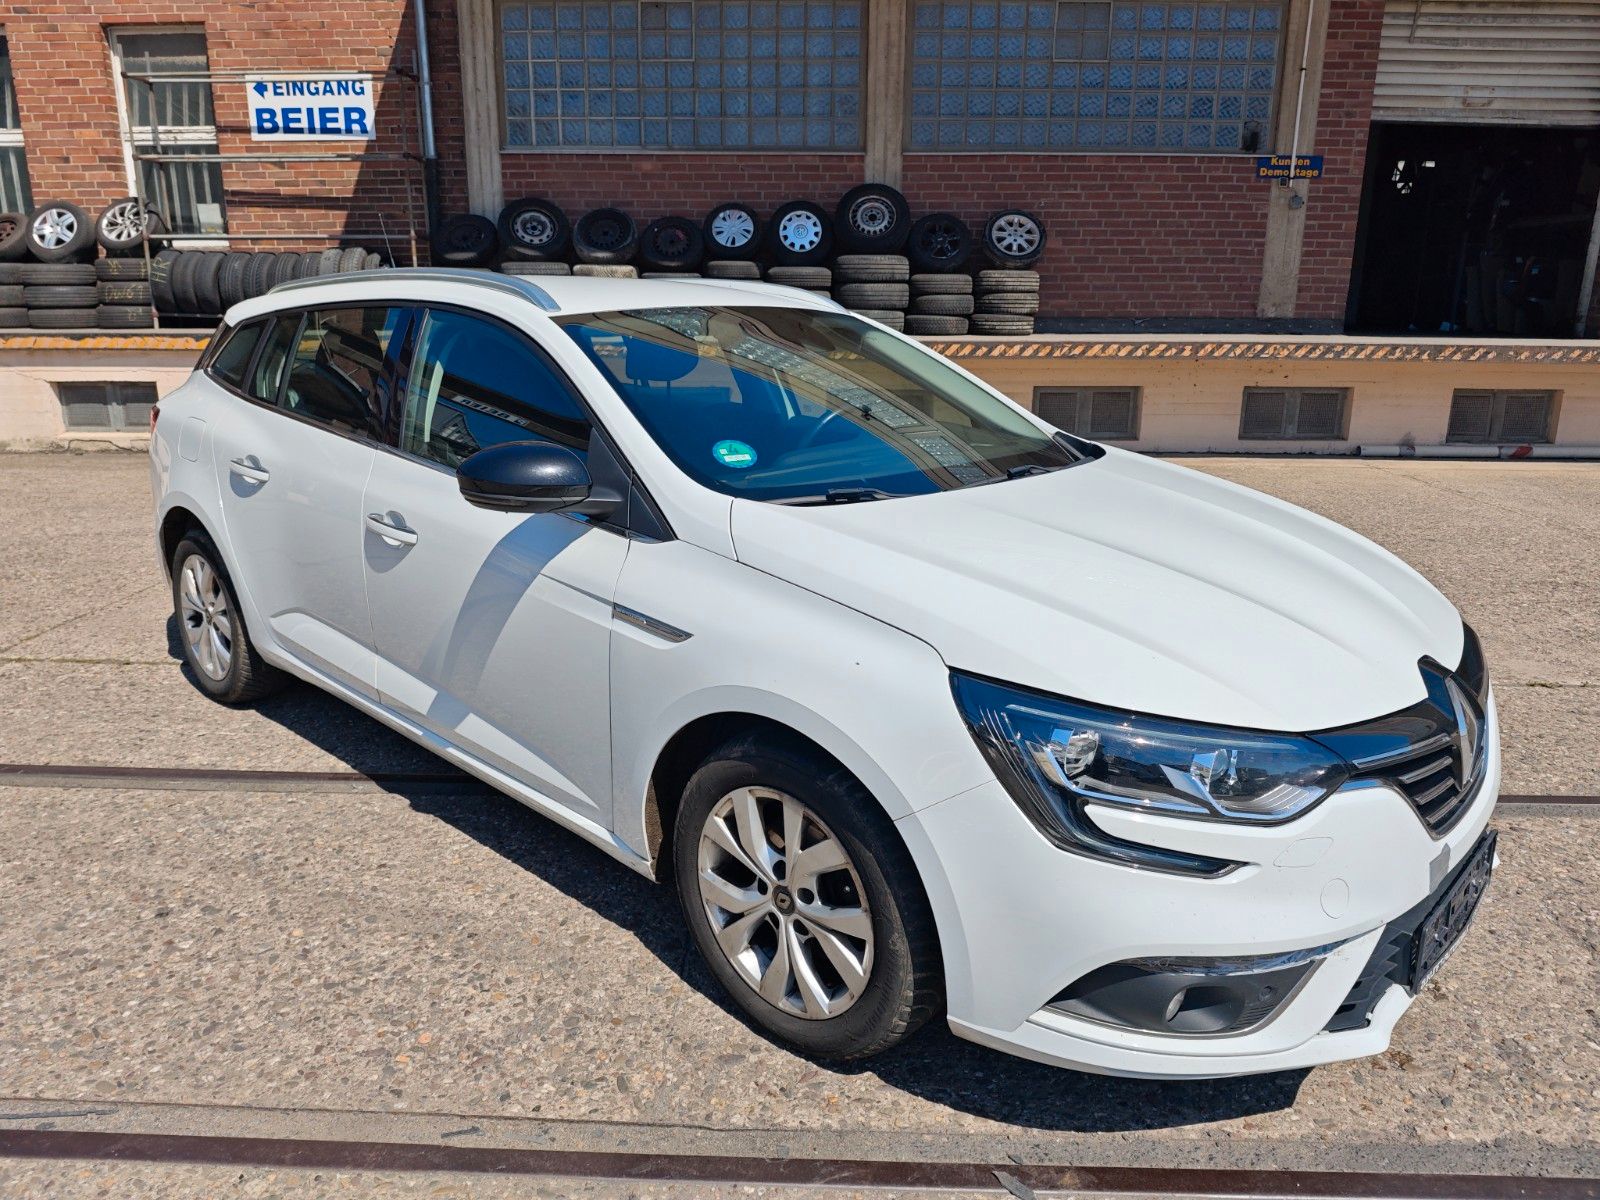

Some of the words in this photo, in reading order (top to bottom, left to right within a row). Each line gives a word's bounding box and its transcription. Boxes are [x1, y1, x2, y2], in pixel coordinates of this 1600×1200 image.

[272, 80, 366, 96] EINGANG
[255, 107, 369, 134] BEIER
[1271, 156, 1310, 166] Kunen
[1260, 167, 1319, 177] Demotage
